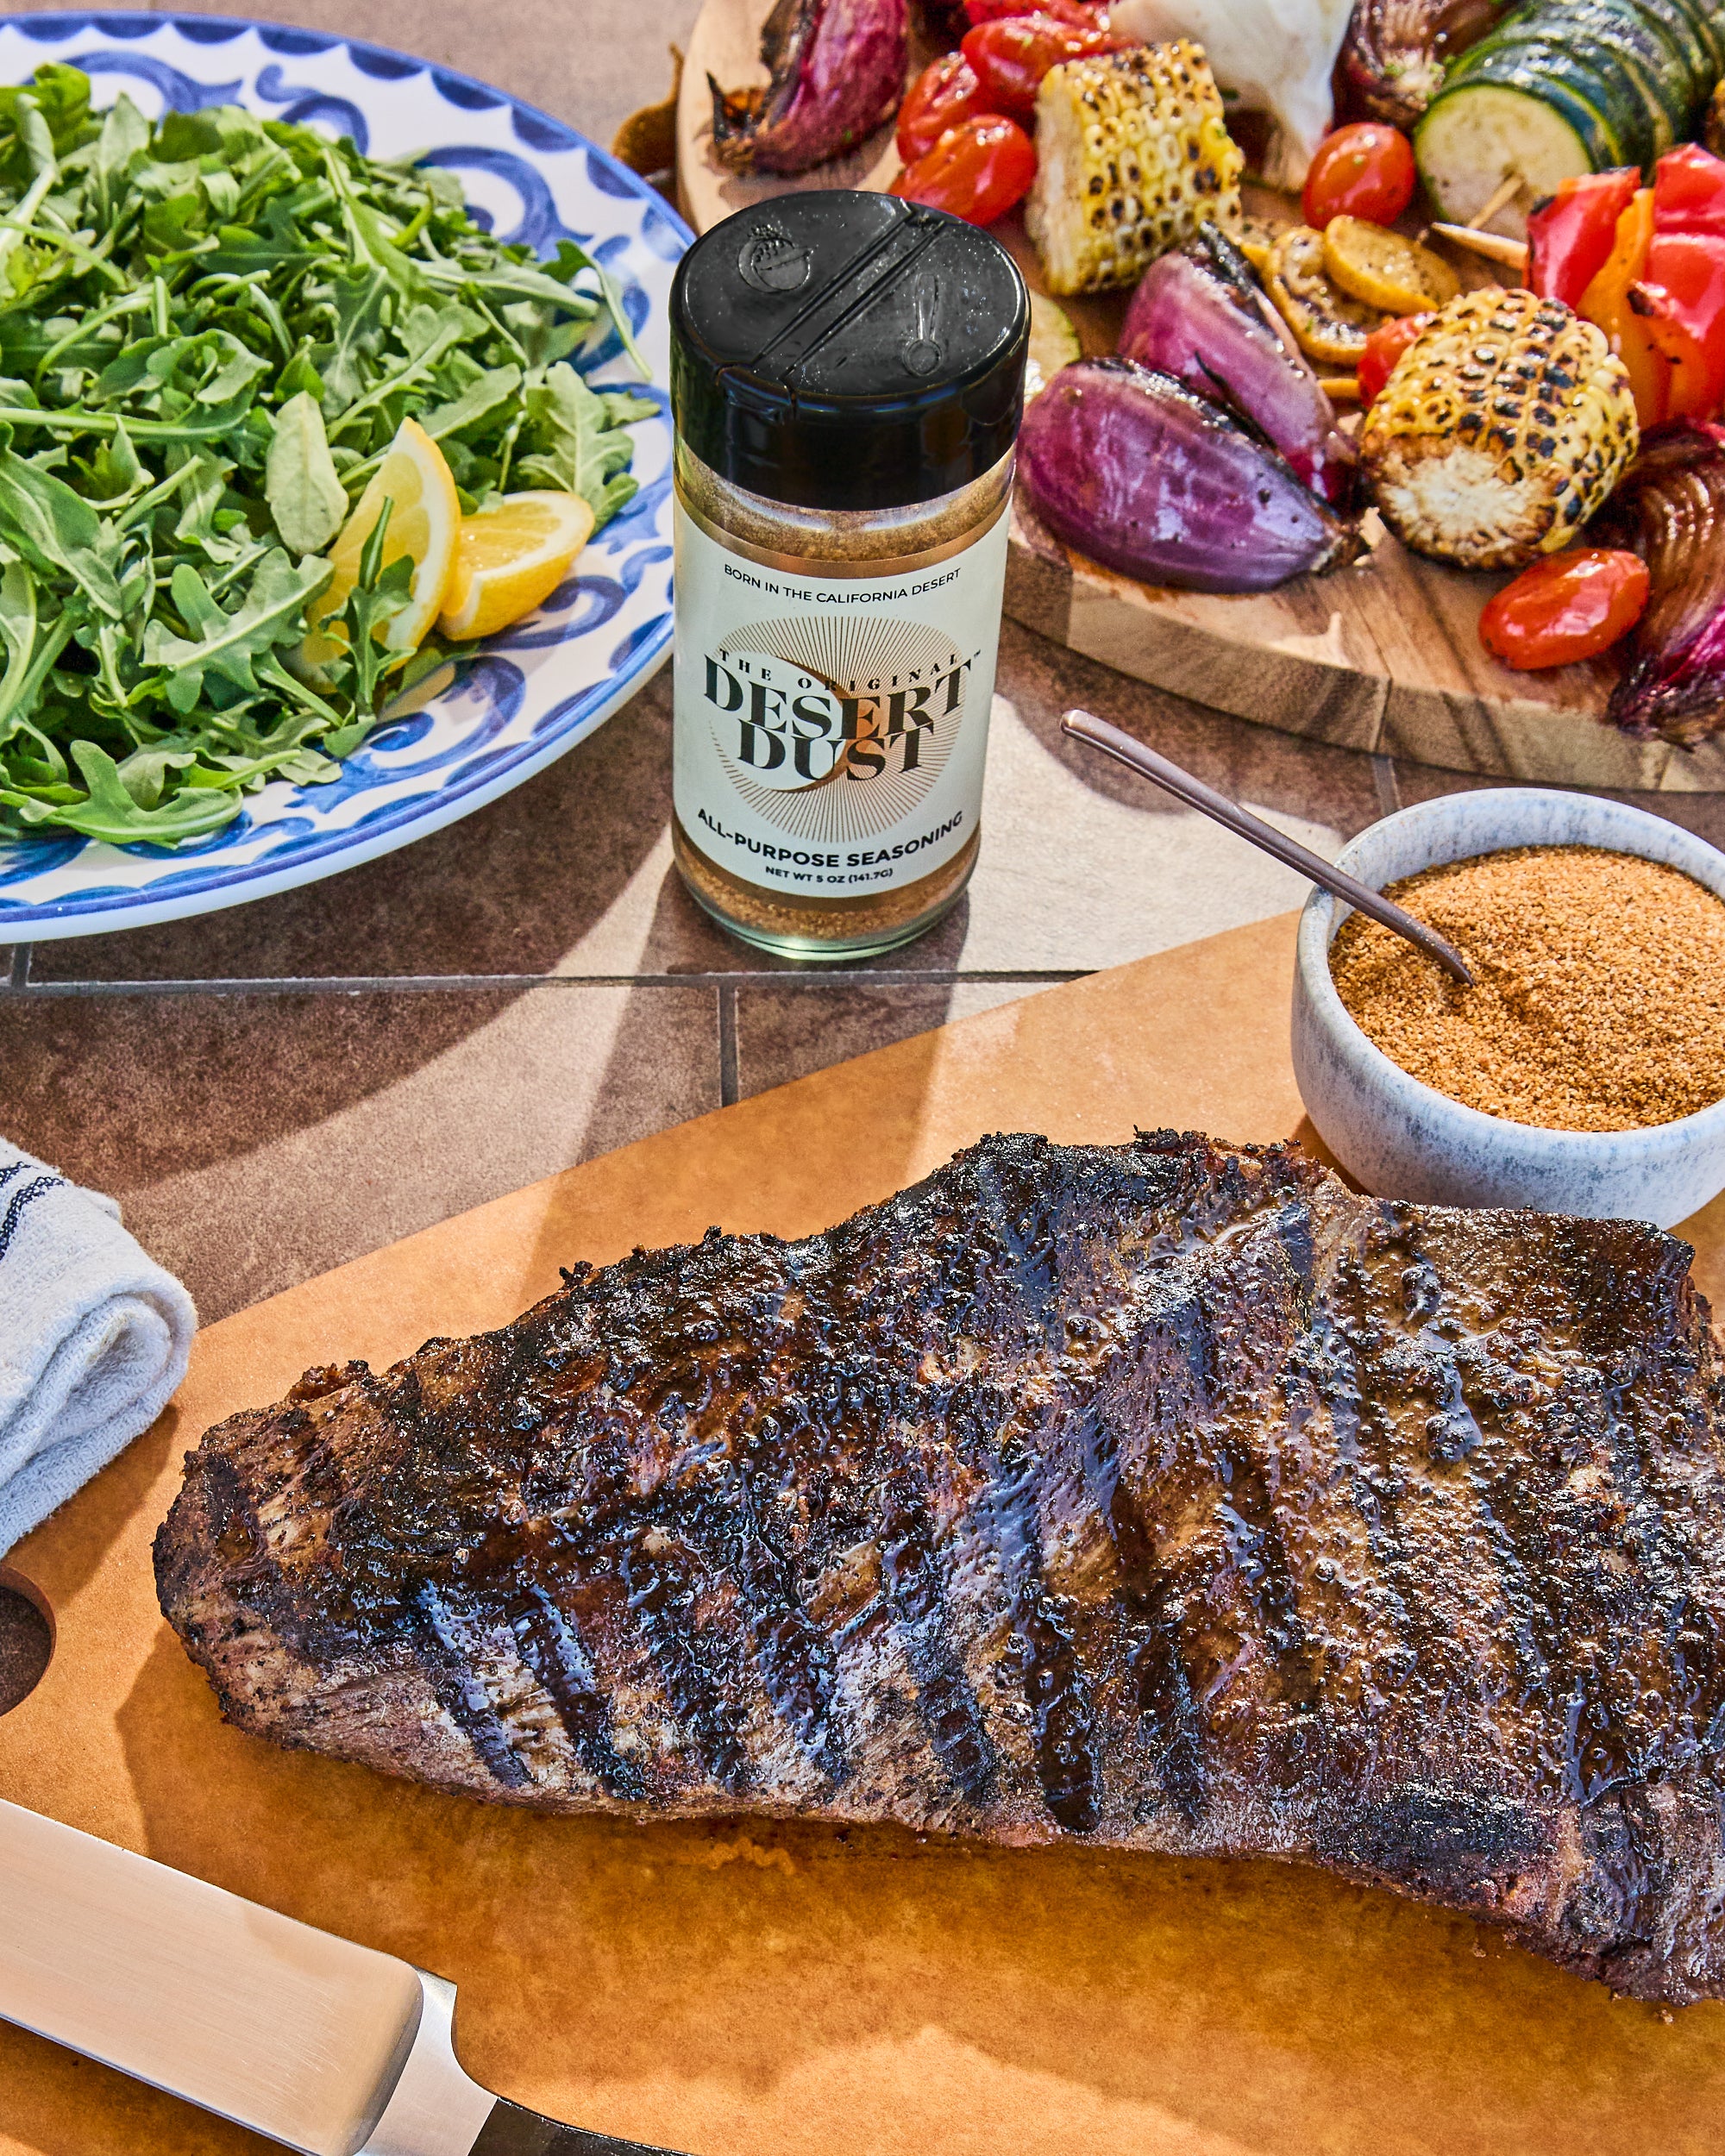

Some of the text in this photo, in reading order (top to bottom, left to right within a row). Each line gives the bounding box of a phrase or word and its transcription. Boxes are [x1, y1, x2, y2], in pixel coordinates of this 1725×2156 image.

[724, 563, 962, 604] BORN IN THE CALIFORNIA DESERT
[718, 649, 958, 691] THE ORIGINAL
[703, 653, 972, 740] DESERT
[737, 718, 935, 780] DUST
[697, 808, 963, 868] ALL-PURPOSE SEASONING
[765, 866, 791, 879] NET
[794, 871, 813, 882] WT
[827, 874, 845, 883] OZ
[849, 868, 894, 884] (141.7G)
